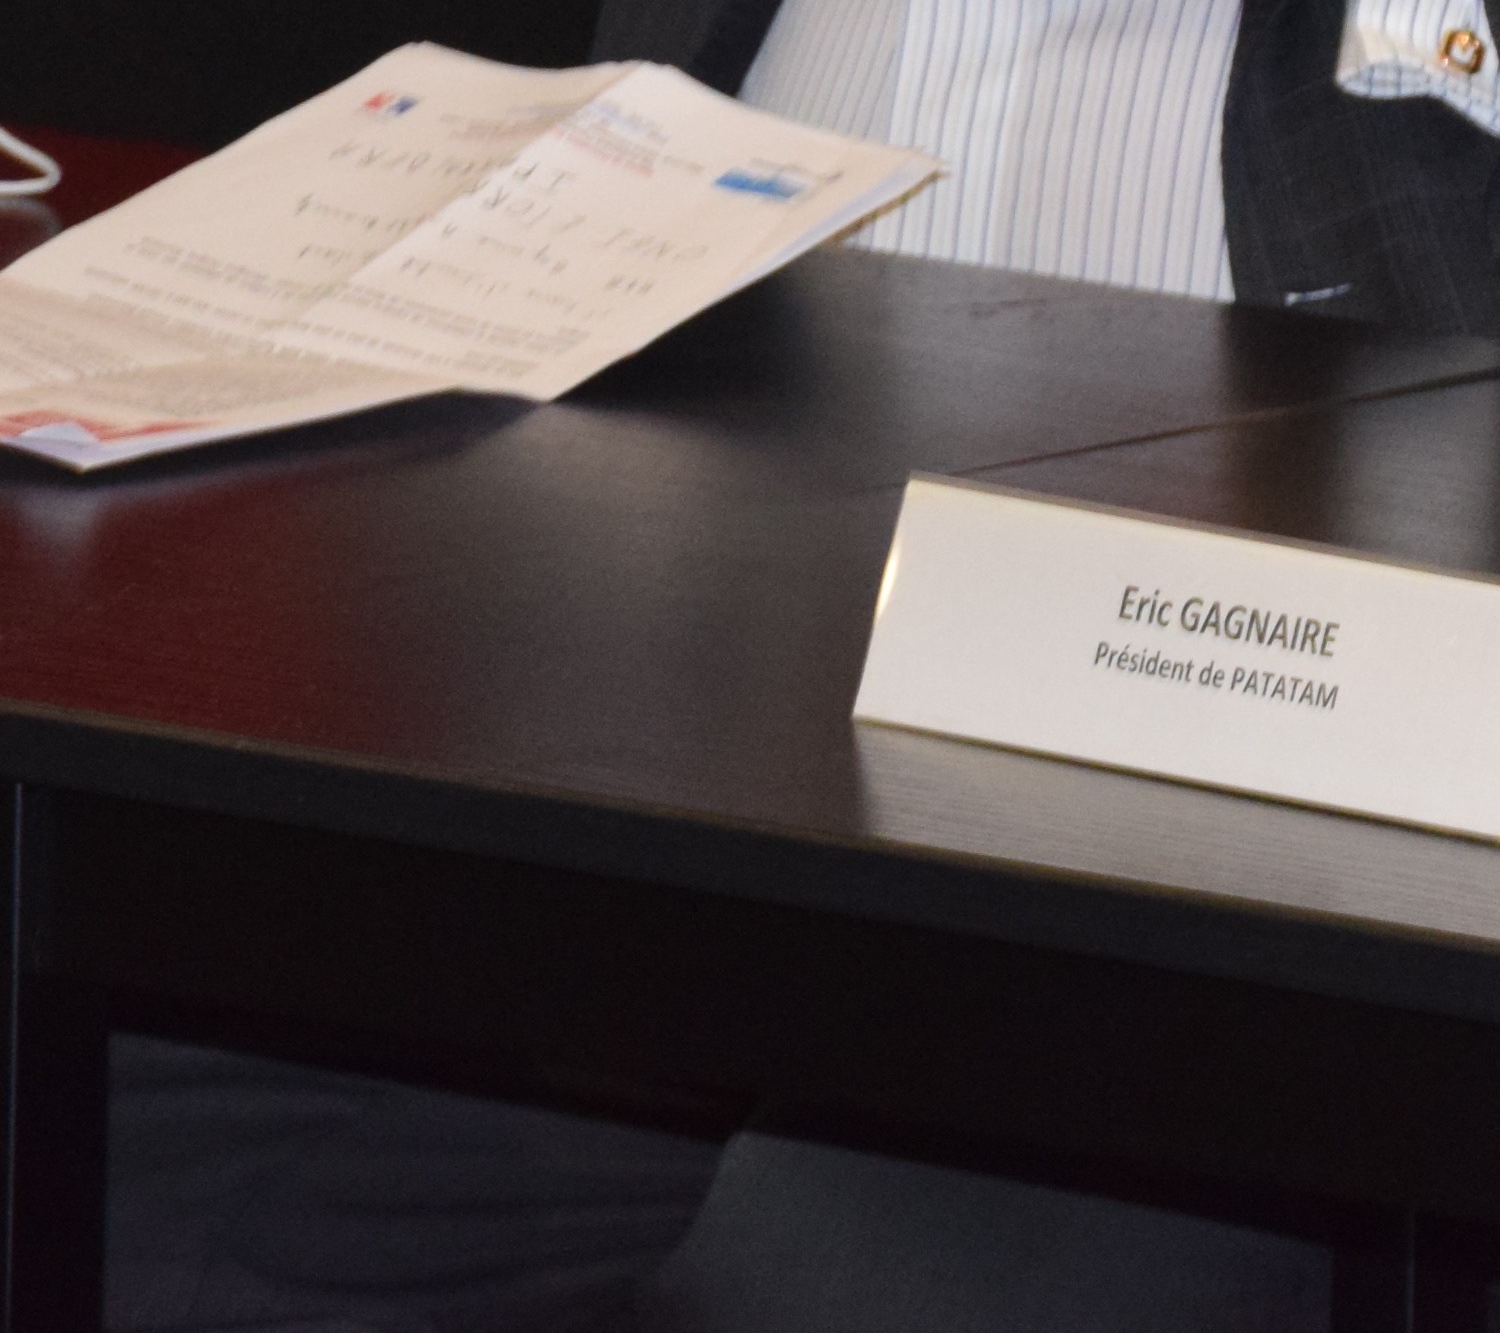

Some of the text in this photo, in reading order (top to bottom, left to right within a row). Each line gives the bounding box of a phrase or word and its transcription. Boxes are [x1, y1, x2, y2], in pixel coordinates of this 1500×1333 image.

[1118, 584, 1341, 658] Eric GAGNAIRE
[1094, 640, 1340, 710] Président de PATATAM
